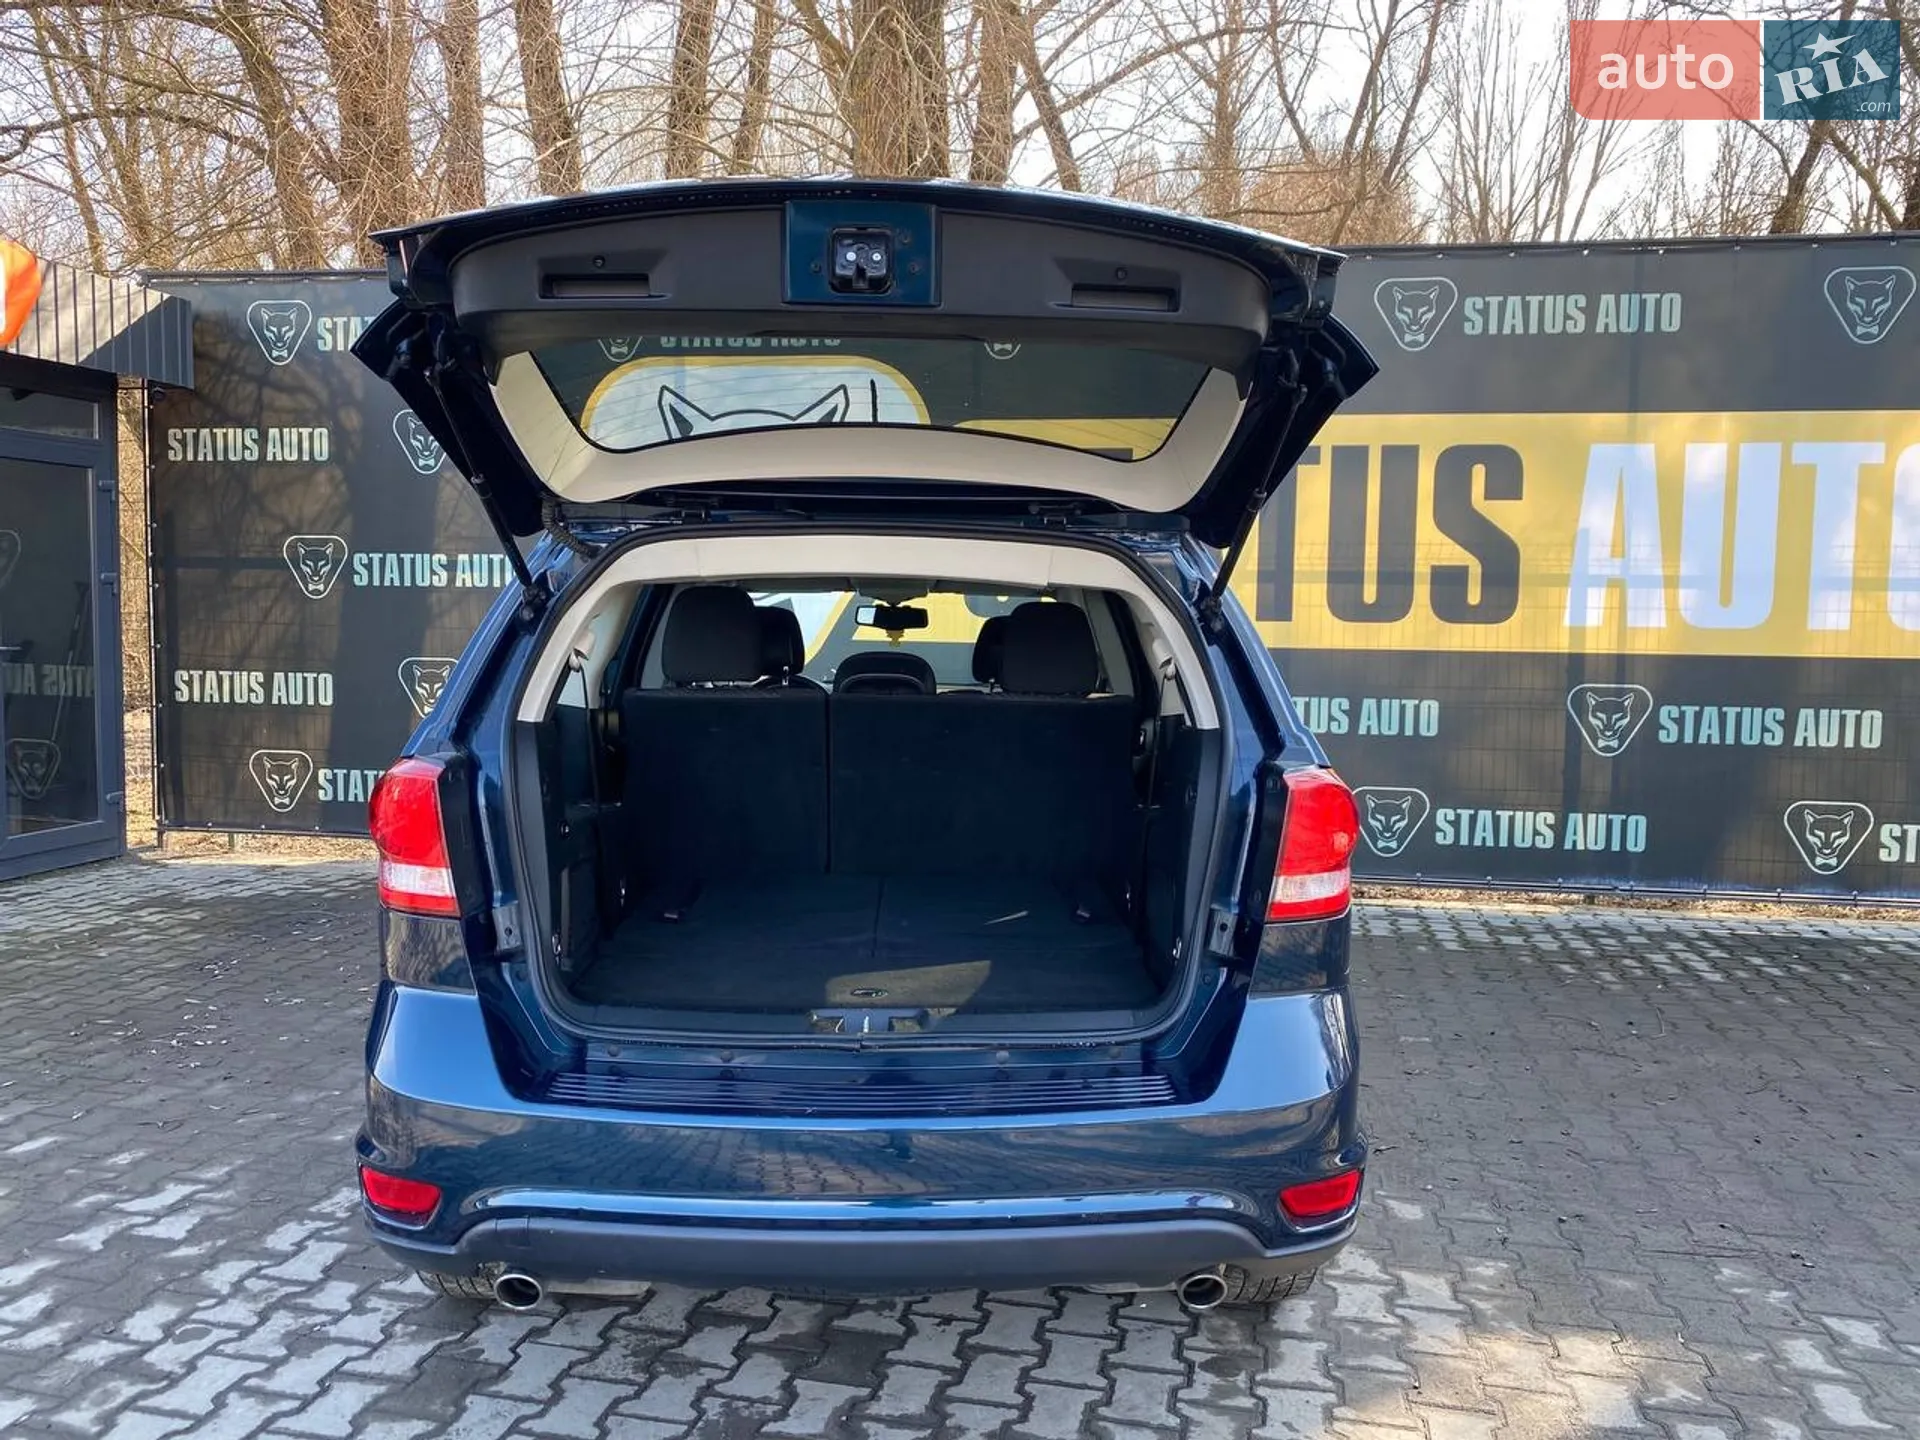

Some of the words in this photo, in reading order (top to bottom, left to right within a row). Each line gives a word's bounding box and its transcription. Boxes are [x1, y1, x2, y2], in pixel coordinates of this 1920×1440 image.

[1463, 294, 1586, 335] STATUS
[1595, 292, 1682, 333] AUTO
[317, 316, 376, 351] STA
[168, 428, 259, 462] STATUS
[266, 428, 329, 462] AUTO
[353, 552, 448, 587] STATUS
[174, 670, 265, 705] STATUS
[271, 672, 334, 706] AUTO
[1358, 698, 1439, 737] AUTO
[1658, 705, 1785, 746] STATUS
[1793, 708, 1883, 749] AUTO
[318, 768, 386, 803] STAT
[1435, 808, 1555, 849] STATUS
[1563, 812, 1647, 852] AUTO
